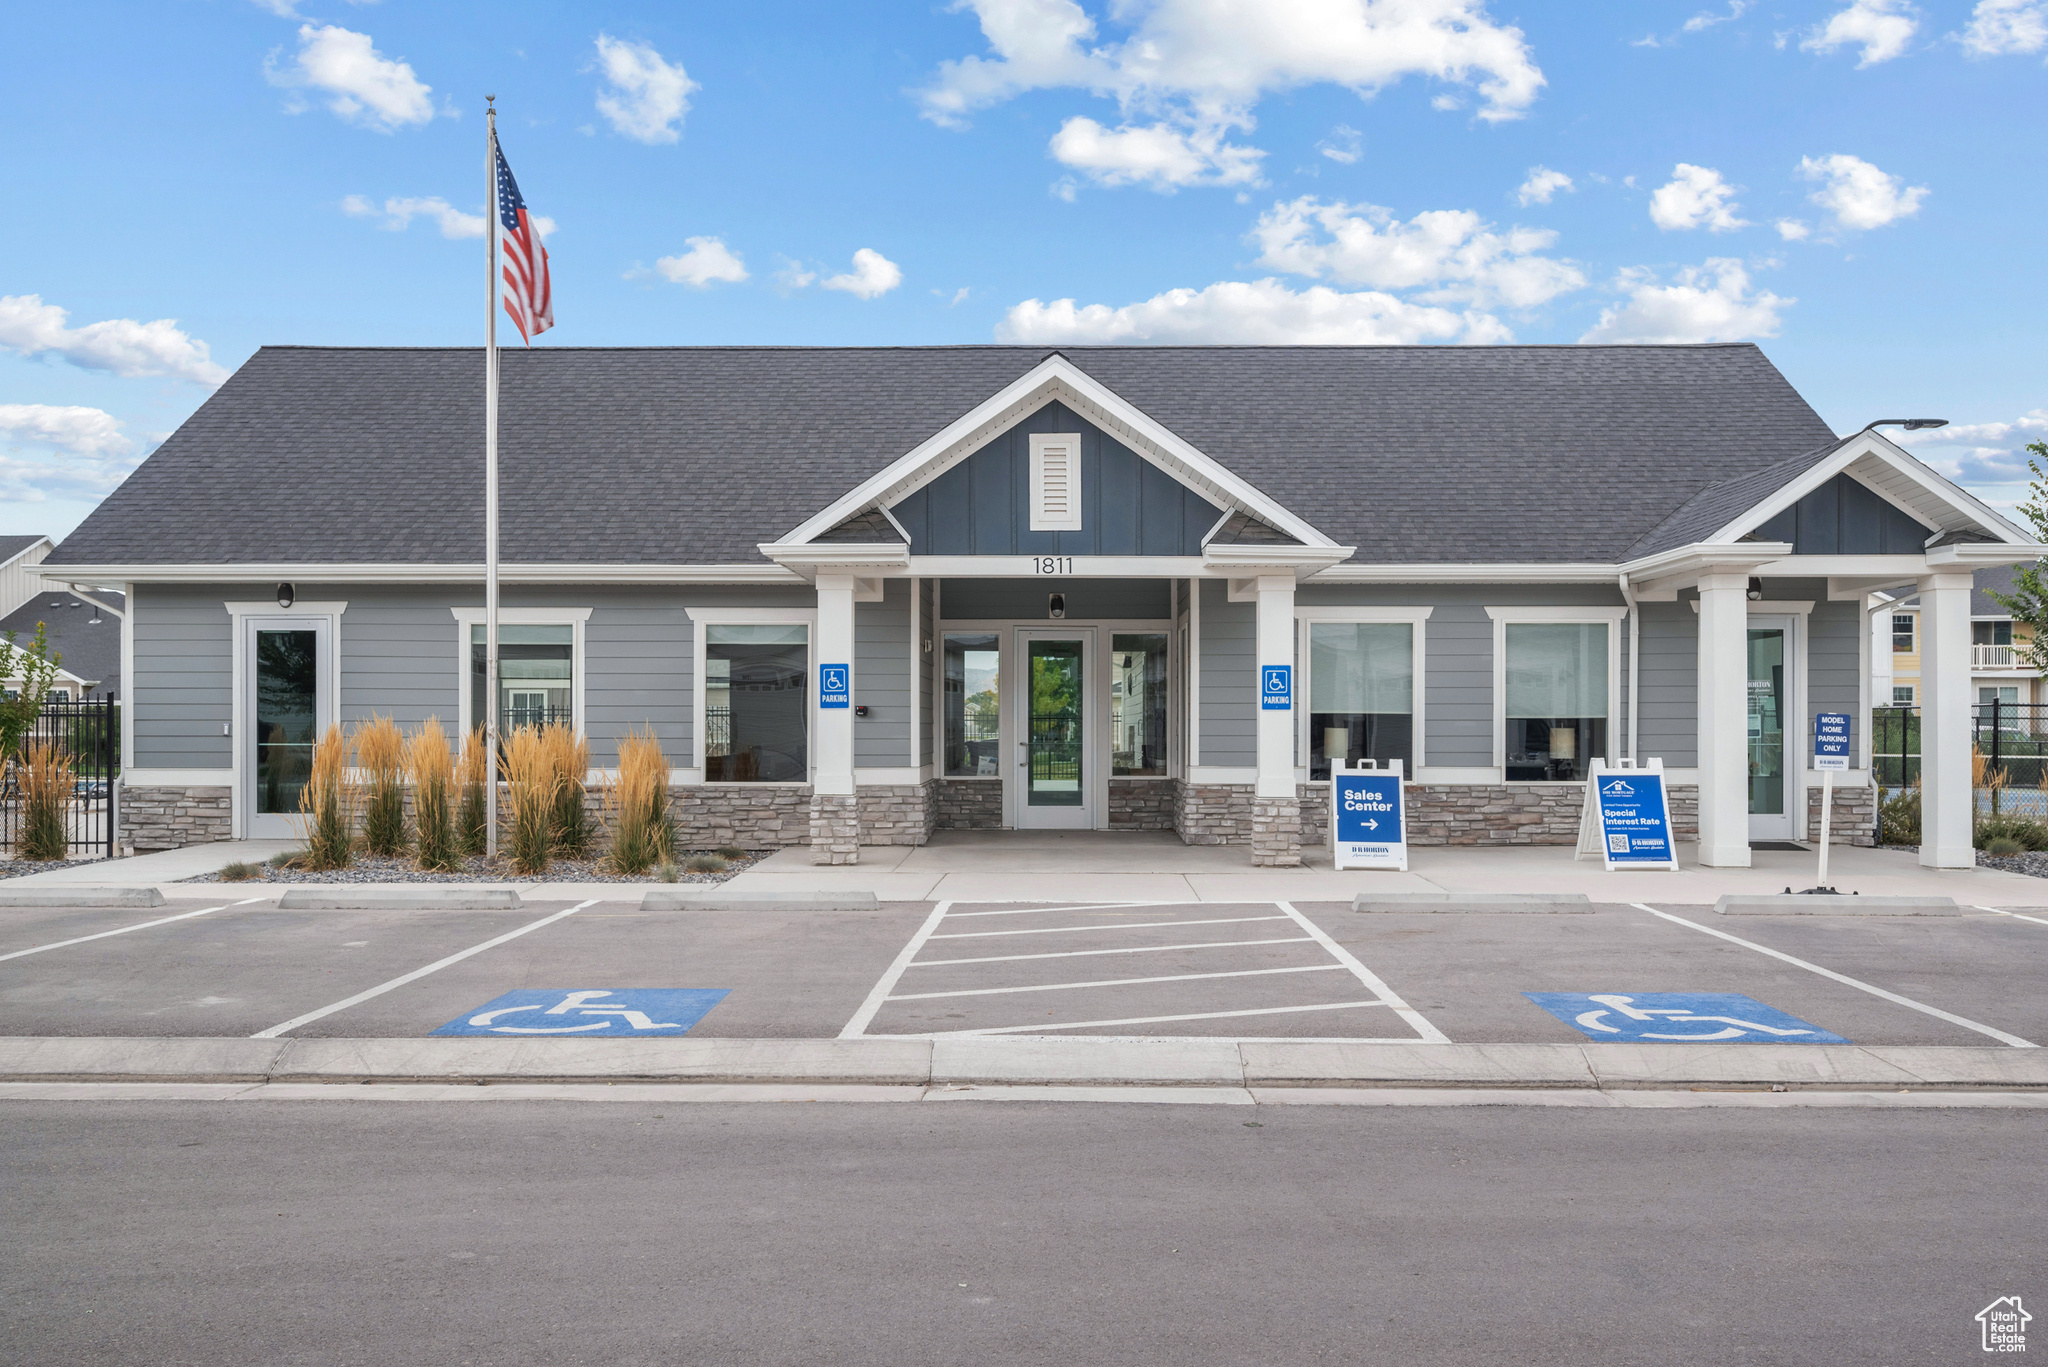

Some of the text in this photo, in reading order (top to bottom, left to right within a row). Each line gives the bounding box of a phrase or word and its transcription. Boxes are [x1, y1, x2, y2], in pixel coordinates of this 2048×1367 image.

[1033, 557, 1072, 574] 1811
[822, 694, 848, 703] PARKING
[1263, 696, 1290, 704] PARKING
[1821, 716, 1846, 724] MODEL
[1817, 735, 1848, 743] PARKING
[1823, 744, 1842, 752] ONLY
[1344, 789, 1383, 801] Sales
[1344, 800, 1393, 812] Center
[1604, 809, 1636, 818] Special
